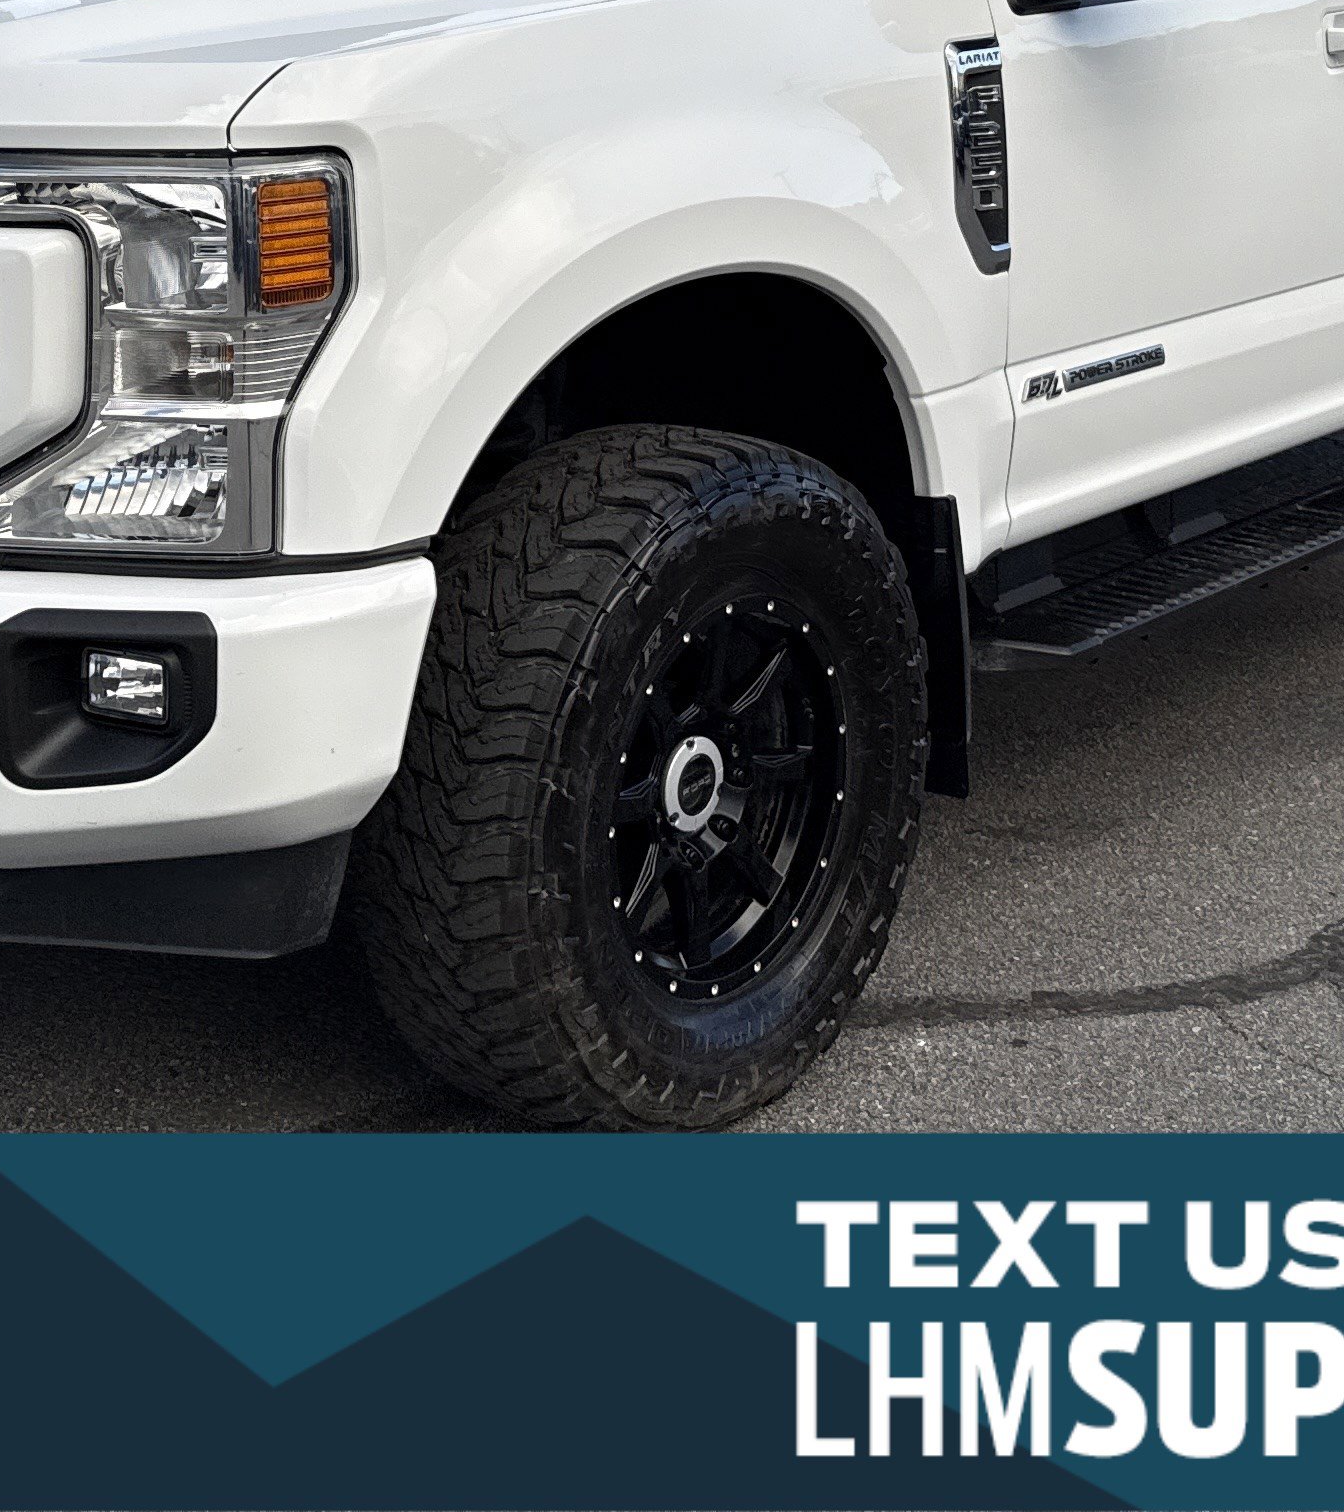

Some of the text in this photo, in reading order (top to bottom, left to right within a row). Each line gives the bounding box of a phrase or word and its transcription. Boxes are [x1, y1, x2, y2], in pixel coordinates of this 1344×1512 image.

[958, 50, 1001, 65] LARIAT
[1068, 360, 1114, 384] POWER
[1115, 347, 1164, 371] STROKE
